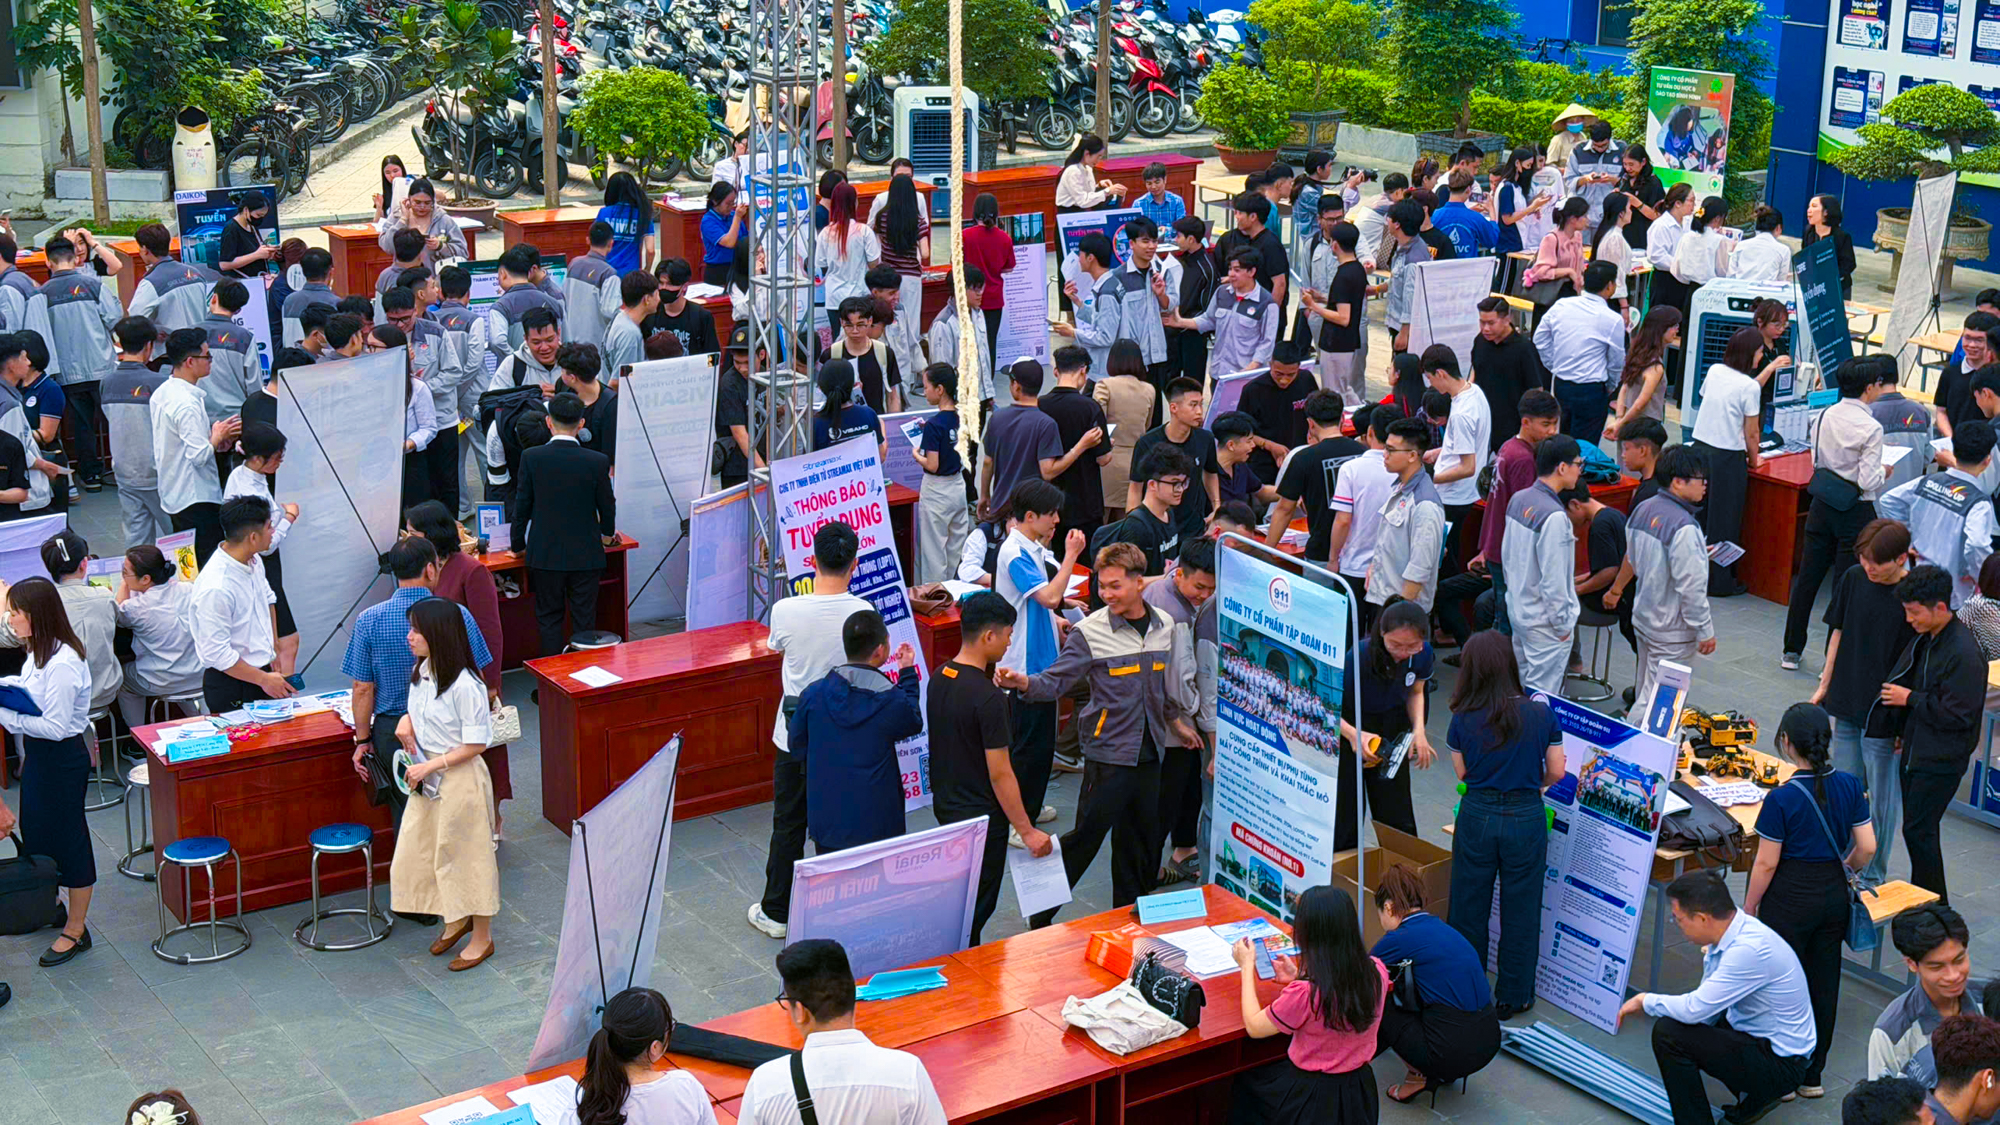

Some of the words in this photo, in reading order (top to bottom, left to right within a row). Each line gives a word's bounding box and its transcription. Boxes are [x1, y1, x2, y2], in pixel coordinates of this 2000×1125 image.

[176, 192, 206, 200] DAIKON
[194, 210, 226, 224] TUYỂN
[789, 480, 796, 490] TY
[796, 476, 808, 489] TNHH
[808, 472, 820, 486] ĐIỆN
[827, 464, 852, 480] STREAMAX
[852, 459, 864, 473] VIỆT
[864, 456, 876, 469] NAM
[803, 456, 842, 472] Streamax
[794, 490, 838, 516] THÔNG
[839, 480, 866, 502] BÁO
[1925, 480, 1953, 498] SKILLING
[1953, 492, 1966, 502] UP
[860, 558, 878, 577] THÔNG
[884, 570, 898, 582] SMT)
[884, 588, 902, 608] NGHIỆP
[1274, 588, 1289, 603] 911
[1224, 596, 1242, 618] CÔNG
[1244, 606, 1252, 620] TY
[1286, 624, 1299, 642] TẬP
[1301, 632, 1320, 652] ĐOÀN
[1322, 642, 1336, 659] 911
[1246, 716, 1260, 734] HOẠT
[1260, 723, 1277, 744] ĐỘNG
[1229, 731, 1246, 746] CUNG
[1247, 737, 1260, 753] CẤP
[1262, 748, 1276, 764] THIẾT
[1277, 756, 1300, 777] BỊ/PHỤ
[1300, 769, 1318, 786] TÙNG
[1219, 738, 1232, 752] MÁY
[1233, 744, 1251, 762] CÔNG
[1252, 756, 1270, 772] TRÌNH
[1270, 764, 1279, 778] VÀ
[1280, 772, 1296, 788] KHAI
[1296, 780, 1315, 800] THÁC
[1316, 790, 1330, 804] MỎ
[1236, 826, 1244, 840] MÃ
[1245, 832, 1262, 848] CHỨNG
[1262, 842, 1282, 863] KHOÁN
